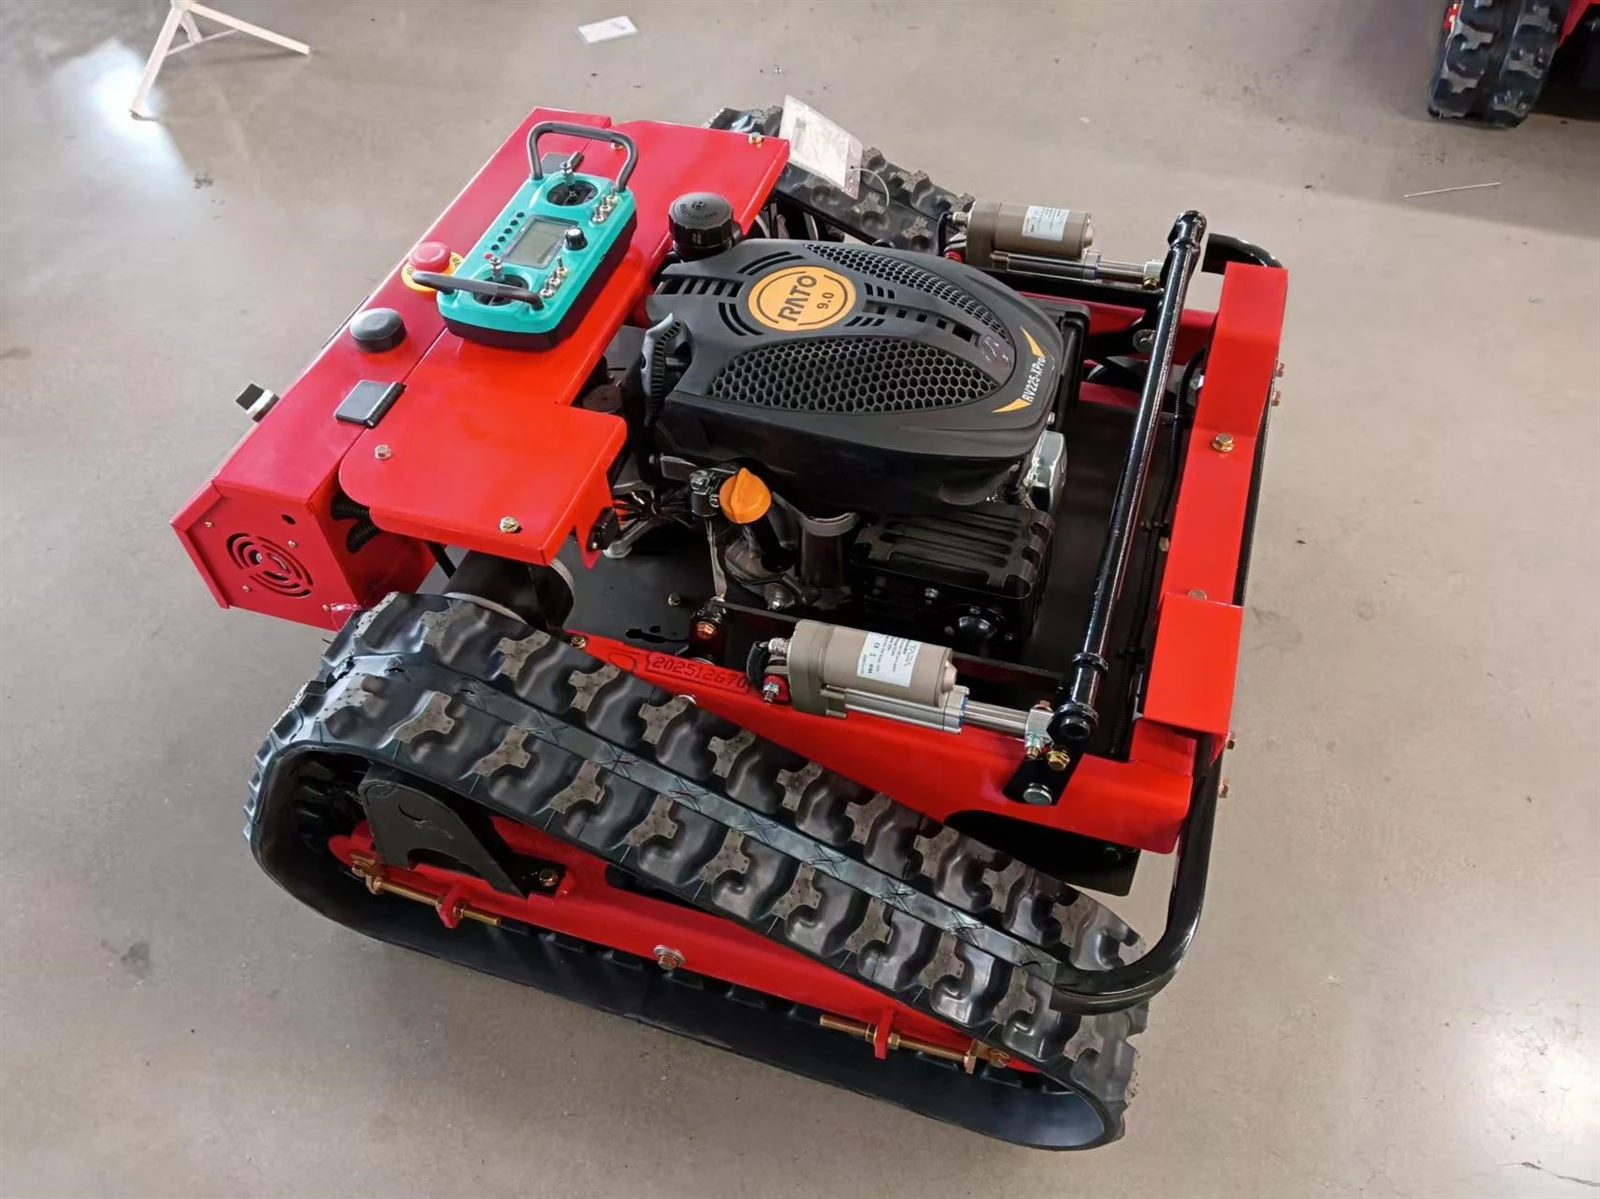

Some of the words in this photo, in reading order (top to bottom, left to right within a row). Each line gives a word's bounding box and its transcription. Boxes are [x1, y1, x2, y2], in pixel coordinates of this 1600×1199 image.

[777, 275, 817, 322] RATO
[817, 292, 834, 309] 9.0
[1021, 357, 1046, 402] RV225-XPro
